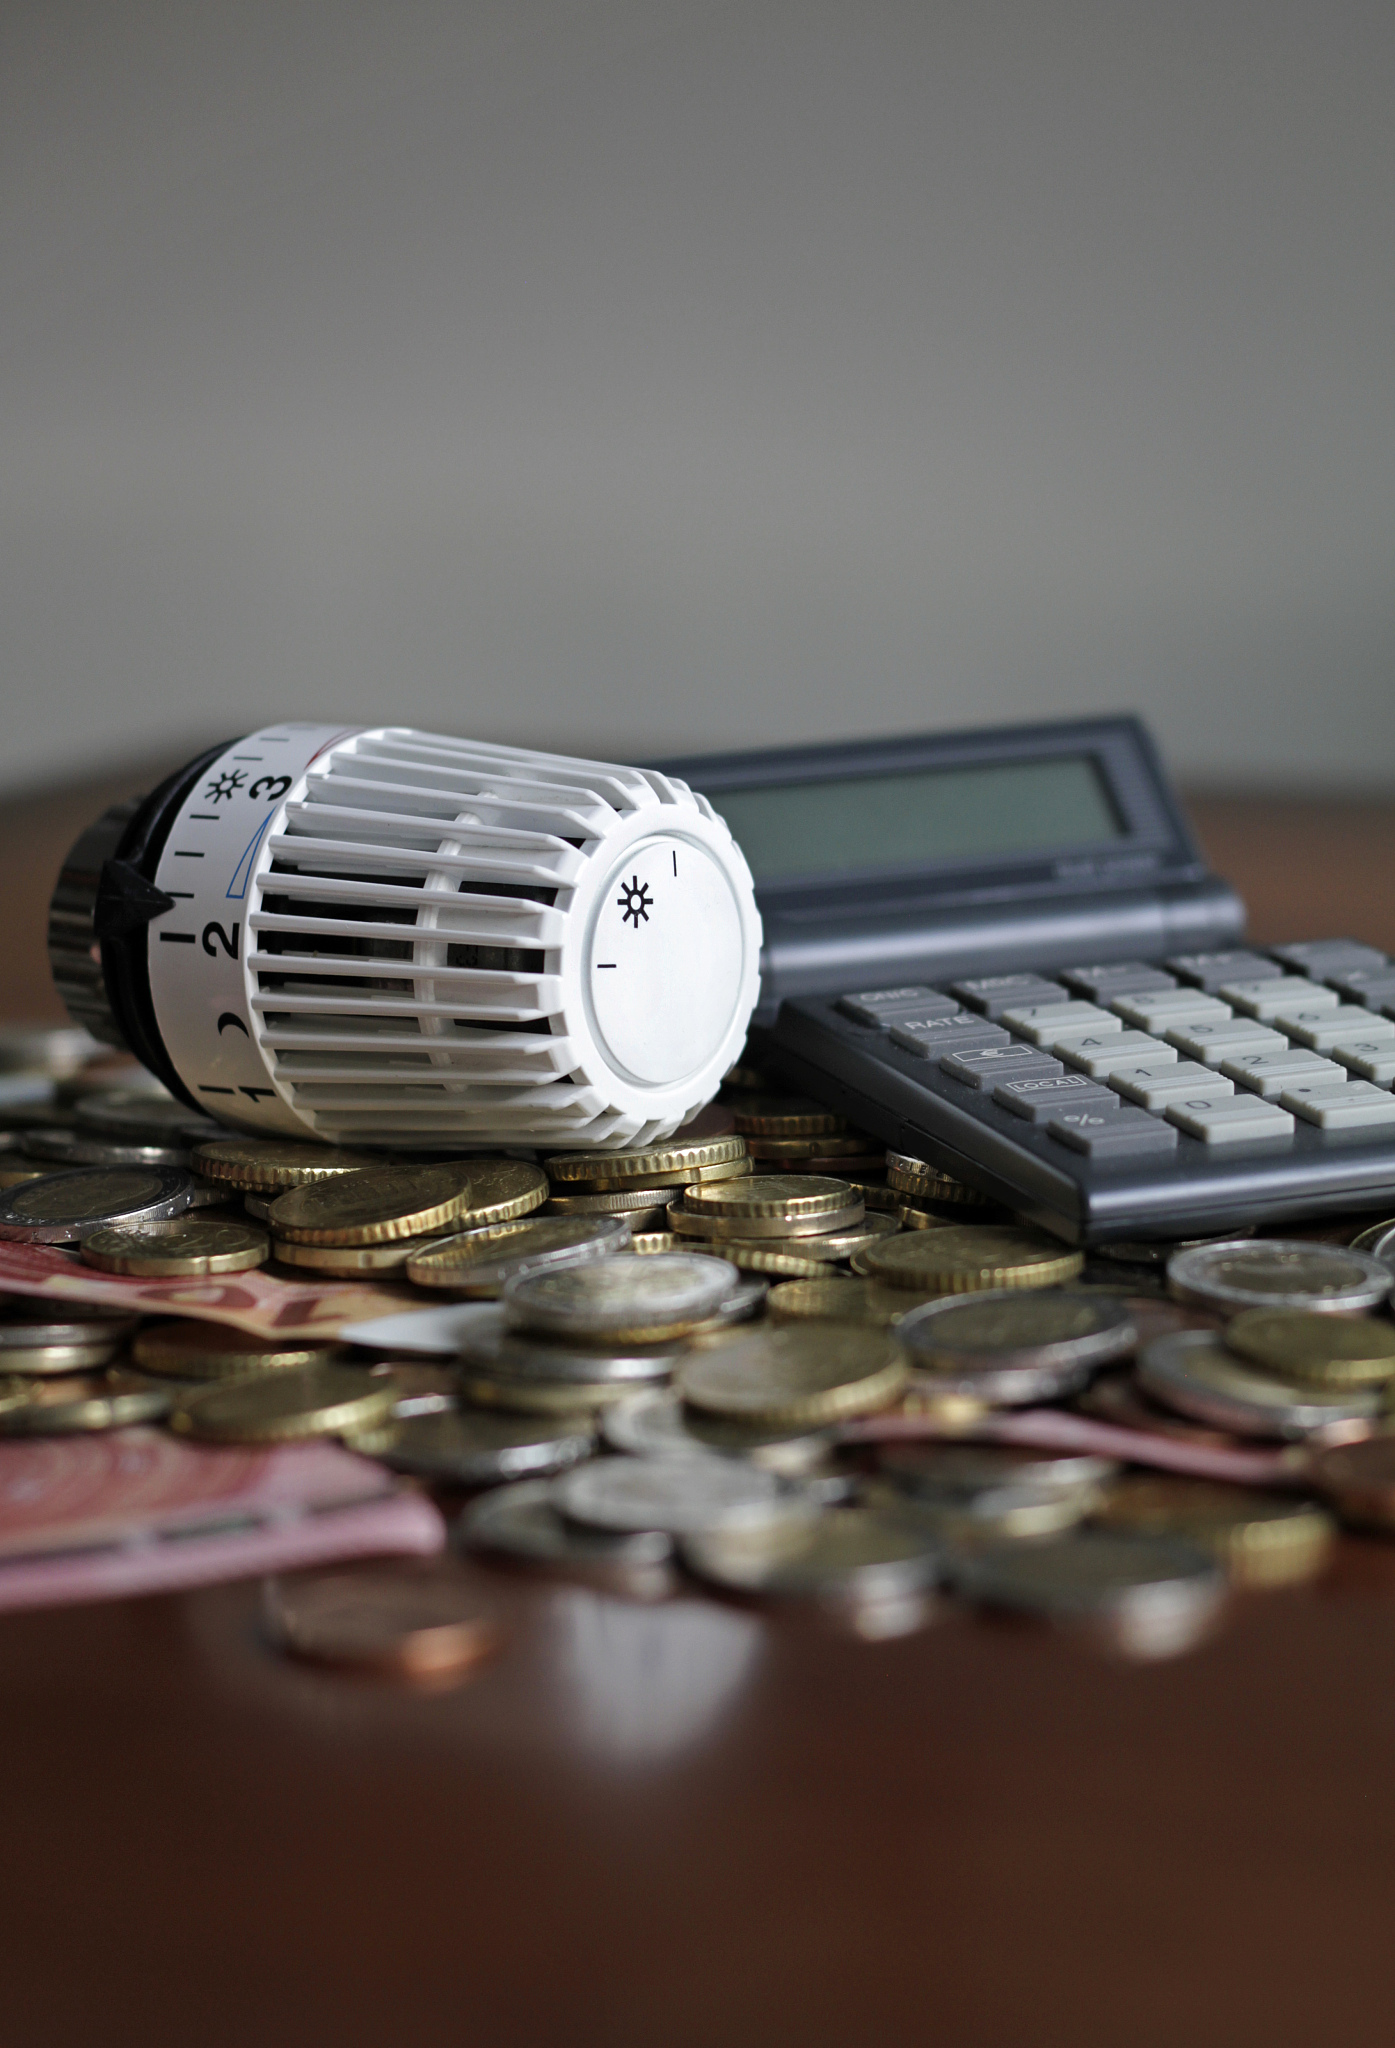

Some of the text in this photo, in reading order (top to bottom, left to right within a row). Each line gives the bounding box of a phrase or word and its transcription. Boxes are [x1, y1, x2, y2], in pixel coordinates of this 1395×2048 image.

[248, 774, 293, 802] 3
[202, 921, 240, 960] 2
[904, 1015, 975, 1030] RATE
[1190, 1025, 1213, 1033] 5
[1081, 1038, 1102, 1046] 4
[1355, 1043, 1379, 1052] 3
[1242, 1055, 1270, 1065] 2
[1135, 1068, 1153, 1077] 1
[1013, 1076, 1080, 1091] LOCAL
[238, 1084, 278, 1103] 1
[1185, 1100, 1212, 1110] 0
[1063, 1113, 1105, 1127] %
